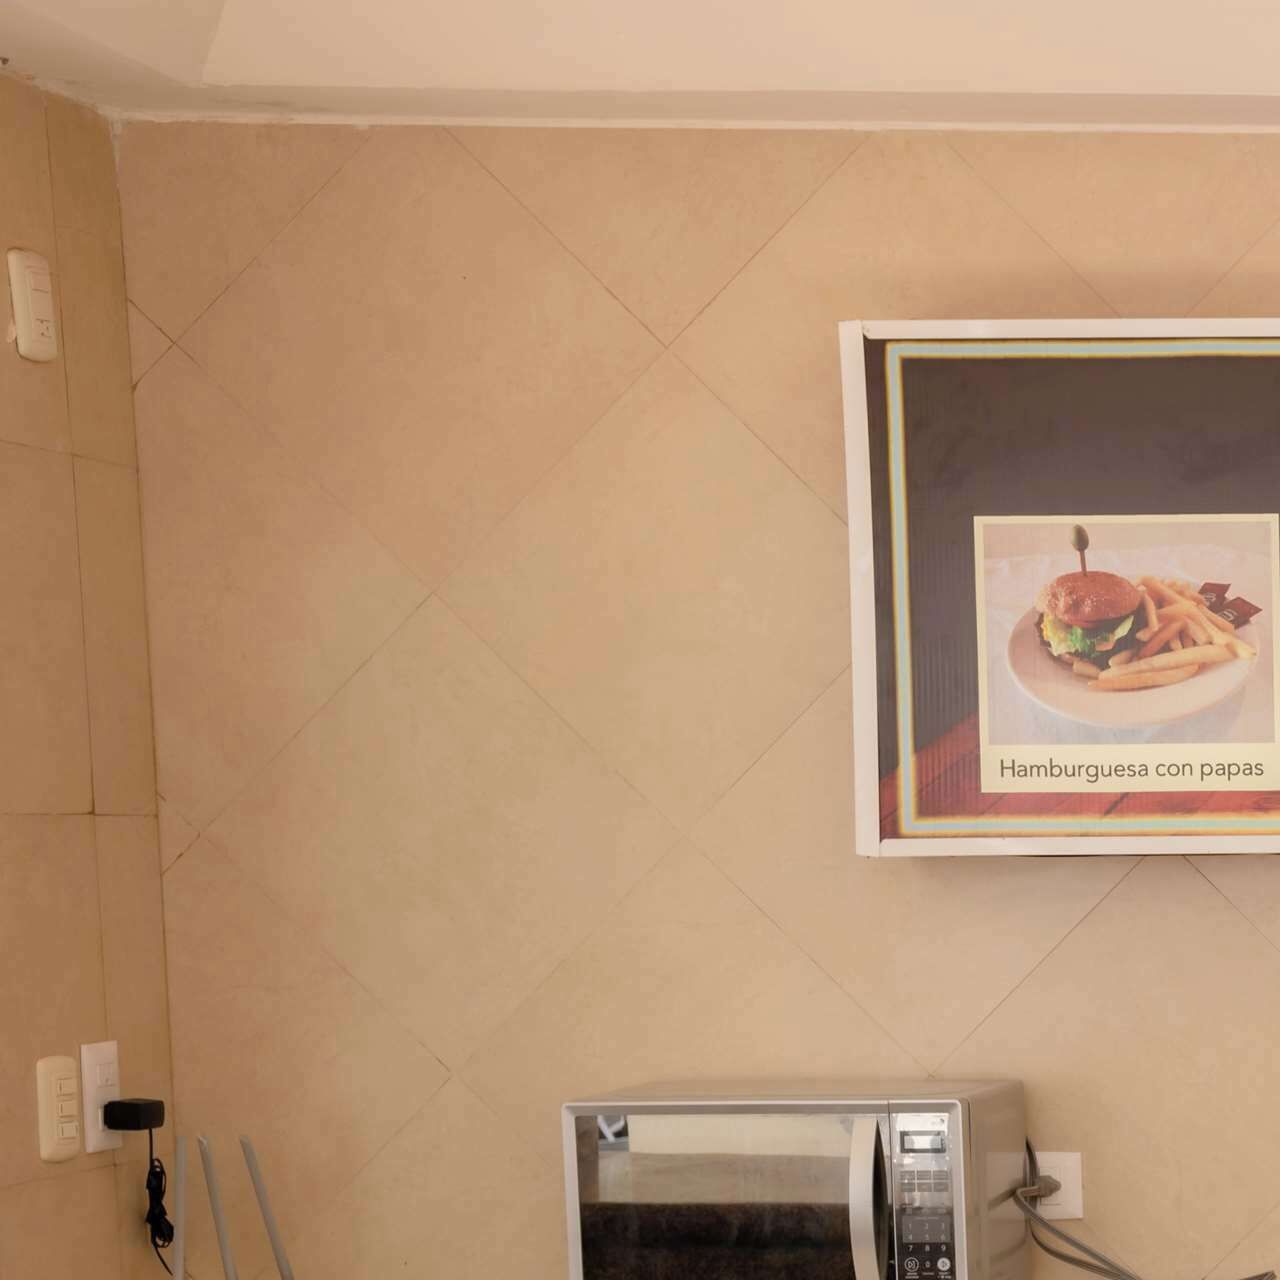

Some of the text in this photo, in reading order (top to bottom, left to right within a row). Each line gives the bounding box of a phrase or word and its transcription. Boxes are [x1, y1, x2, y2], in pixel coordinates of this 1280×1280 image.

[1000, 758, 1264, 783] Hamburguesa con papas
